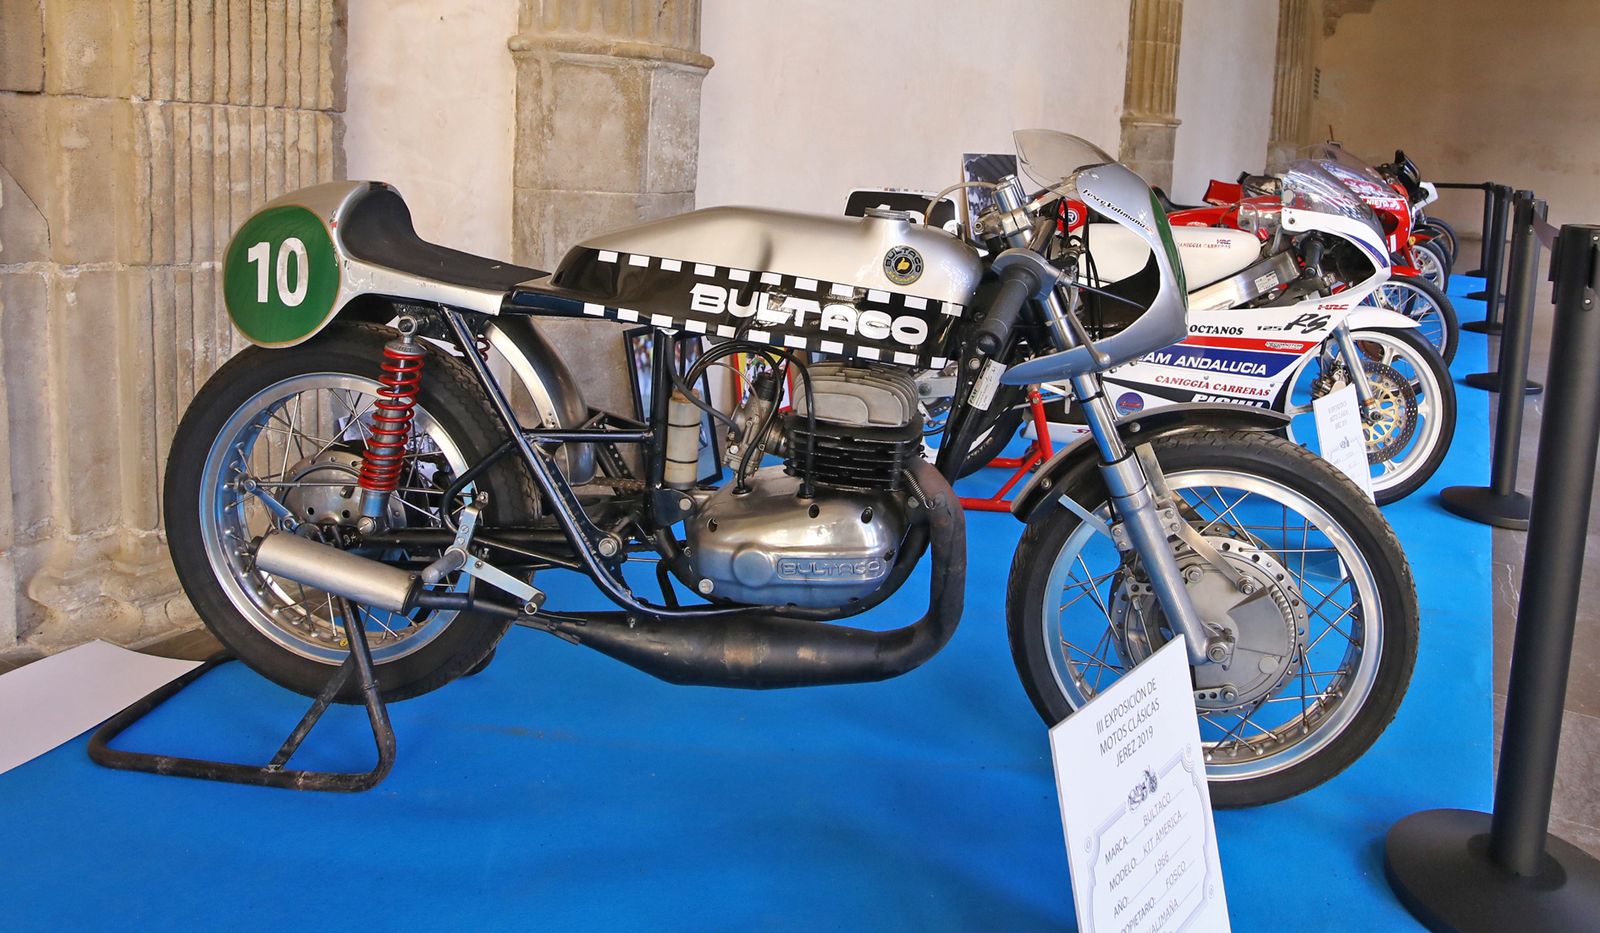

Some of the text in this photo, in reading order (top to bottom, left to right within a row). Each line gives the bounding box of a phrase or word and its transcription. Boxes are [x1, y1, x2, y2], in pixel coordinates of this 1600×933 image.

[247, 237, 309, 307] 10
[885, 247, 921, 273] BULTACO
[690, 282, 928, 345] BULTACO
[1189, 324, 1245, 336] OCTANOS
[1174, 355, 1267, 376] ANDALUCIA
[1154, 375, 1271, 397] CANIGGIA CARRERAS
[781, 561, 881, 576] BULTACO
[1096, 678, 1157, 735] III EXPOSICIÓN DE
[1100, 723, 1128, 757] MOTOS
[1116, 725, 1154, 767] JEREZ 2019
[1143, 792, 1171, 827] BULTACO
[1143, 837, 1154, 857] KIT
[1155, 809, 1182, 842] AMERICA
[1154, 850, 1169, 875] 1966
[1165, 860, 1186, 889] FOSCO
